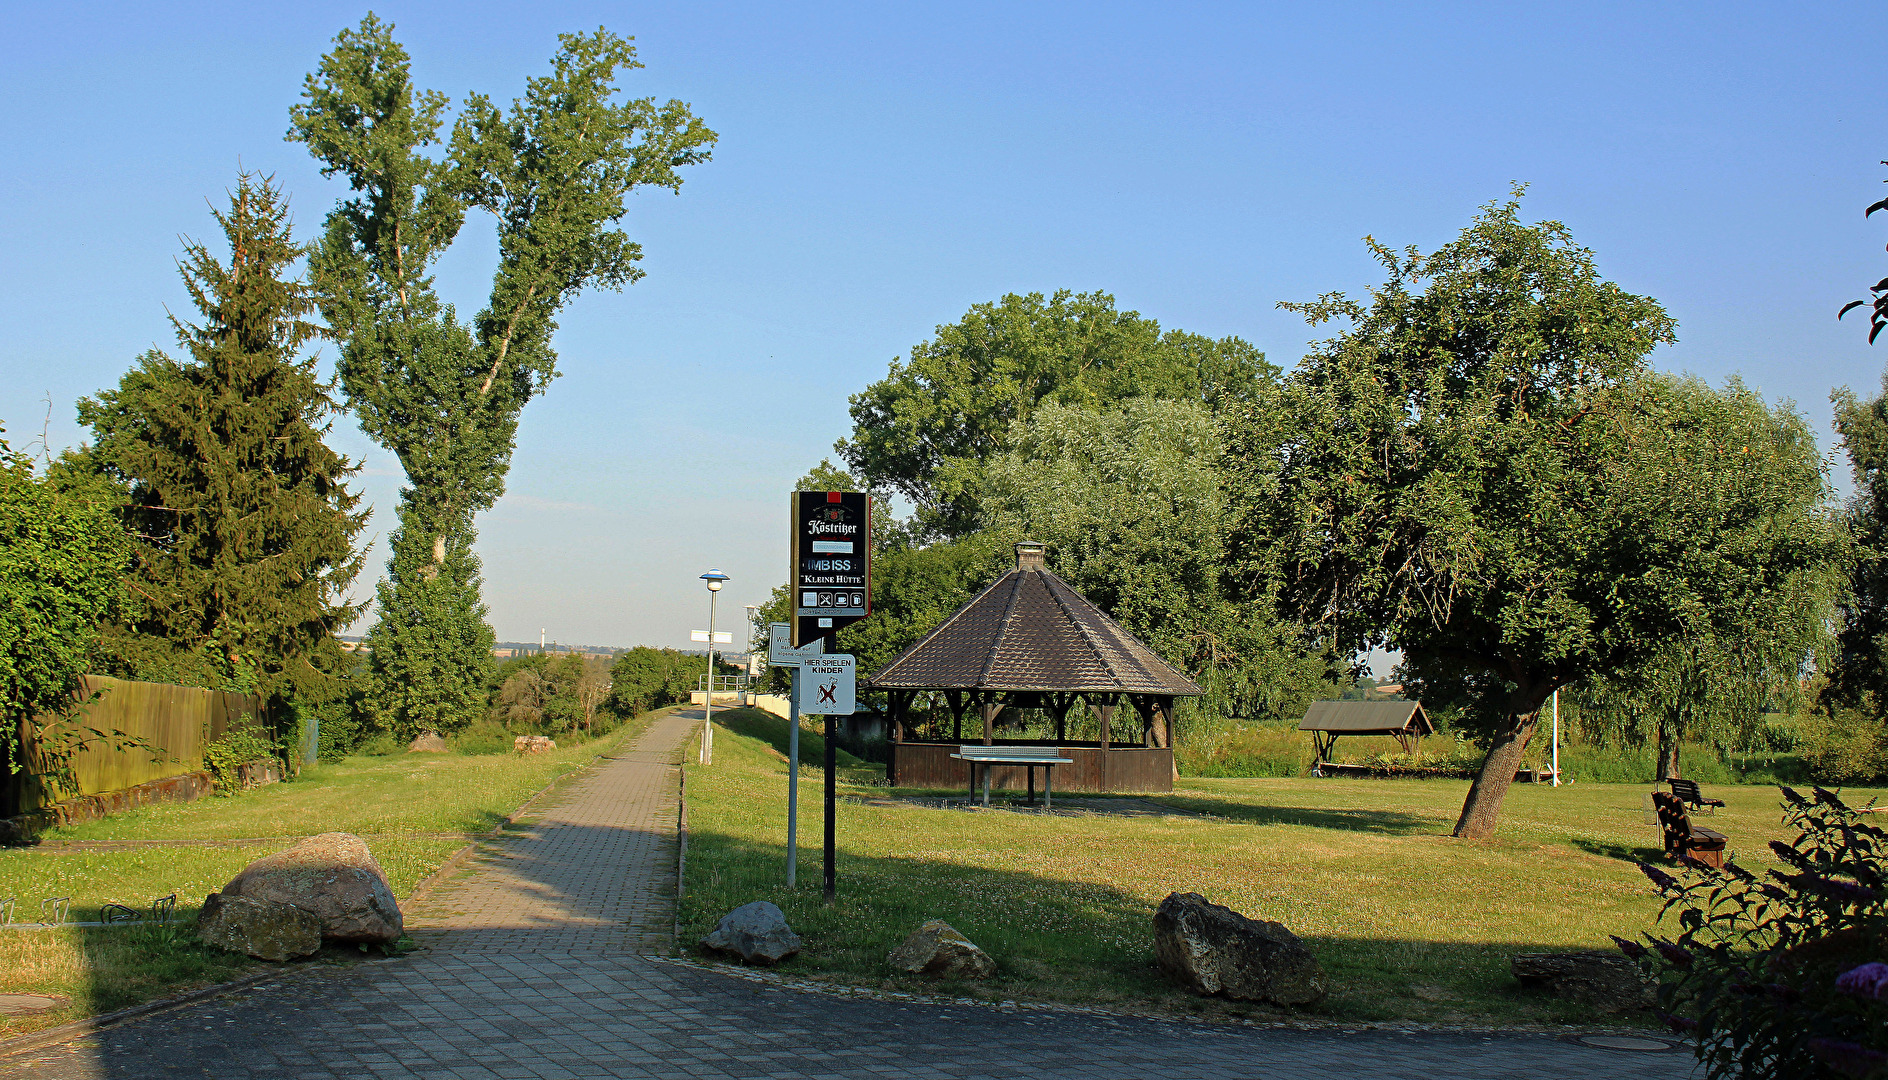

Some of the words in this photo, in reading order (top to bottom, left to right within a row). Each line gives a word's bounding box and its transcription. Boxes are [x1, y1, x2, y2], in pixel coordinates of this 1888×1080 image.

[808, 520, 857, 536] Köstritzer
[808, 559, 851, 571] IMBISS
[822, 659, 851, 667] SPIELEN
